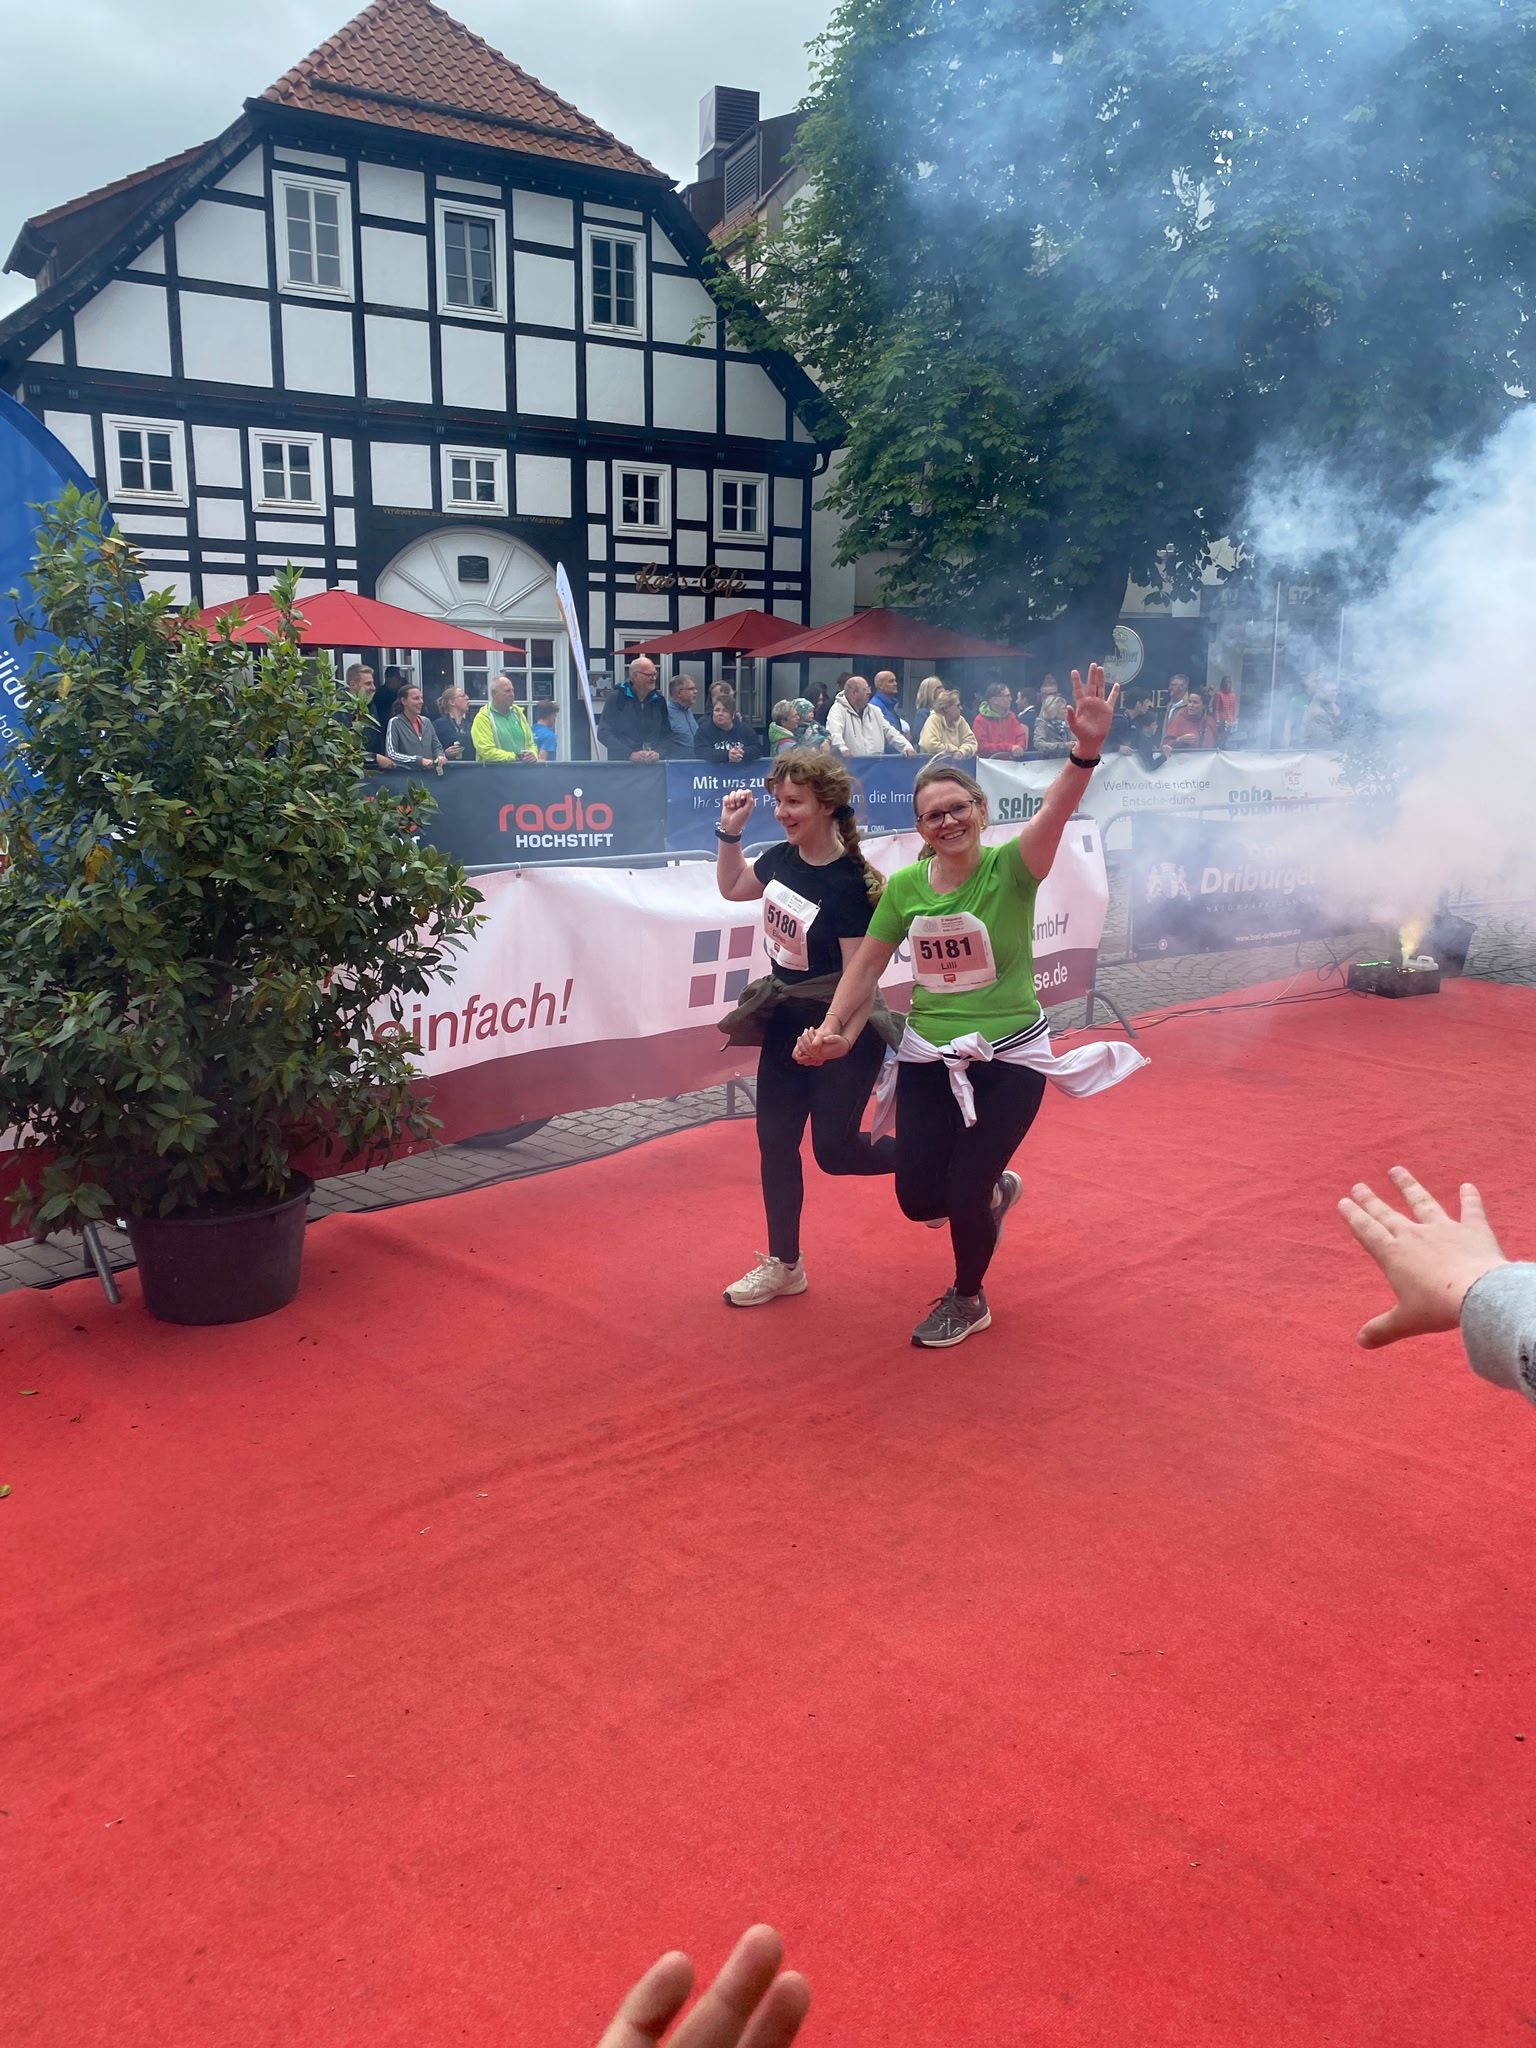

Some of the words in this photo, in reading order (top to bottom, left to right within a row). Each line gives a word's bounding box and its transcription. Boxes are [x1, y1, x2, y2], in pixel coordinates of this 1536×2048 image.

[693, 776, 719, 790] Mit
[722, 778, 746, 789] uns
[1103, 780, 1152, 791] Weltweit
[1154, 780, 1171, 790] die
[1173, 780, 1210, 791] richtige
[693, 795, 710, 809] Ihr
[869, 790, 887, 804] die
[1122, 796, 1196, 807] Entschedung
[499, 788, 613, 832] radio
[516, 833, 614, 849] HOCHSTIFT
[767, 905, 797, 939] 5180
[1033, 912, 1070, 942] mbH
[920, 936, 972, 960] 5181
[373, 978, 574, 1052] einfach!
